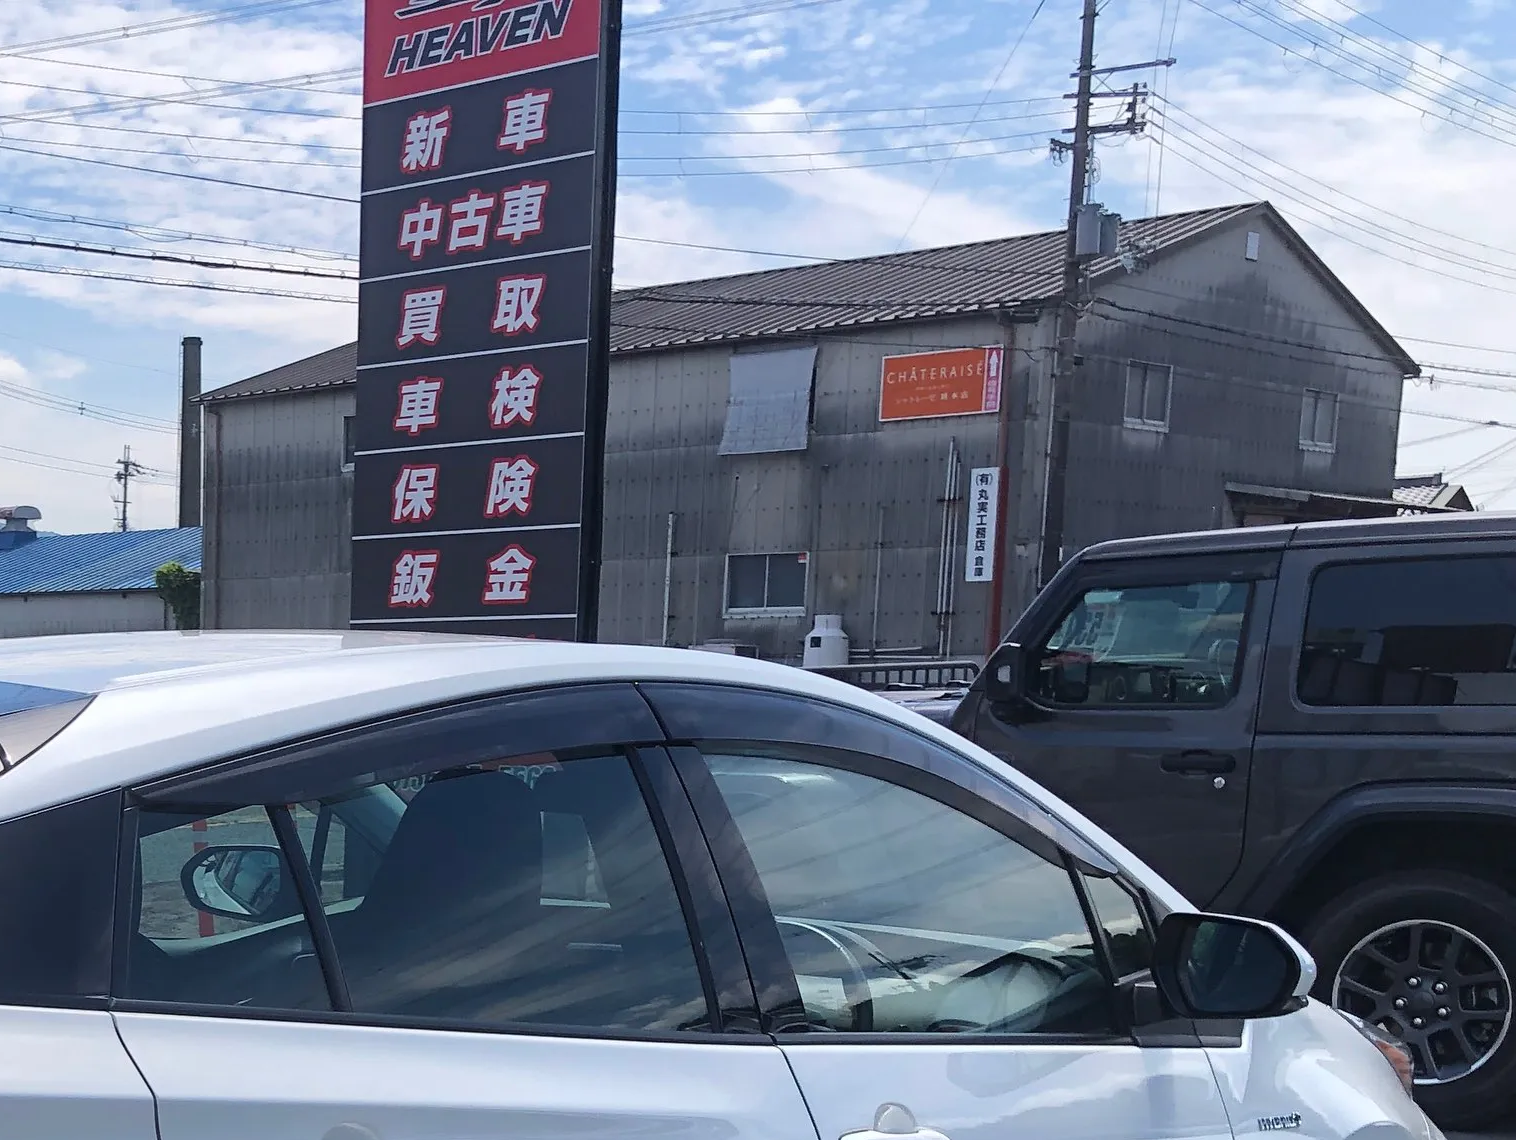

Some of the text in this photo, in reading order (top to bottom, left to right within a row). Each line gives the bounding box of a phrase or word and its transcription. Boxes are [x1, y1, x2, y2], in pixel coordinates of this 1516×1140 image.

[384, 0, 572, 78] HEAVEN
[401, 90, 551, 171] 新車
[399, 183, 548, 258] 中古車
[398, 276, 544, 346] 買取
[394, 366, 540, 433] 車検
[392, 458, 536, 521] 保険
[390, 547, 533, 605] 鈑金
